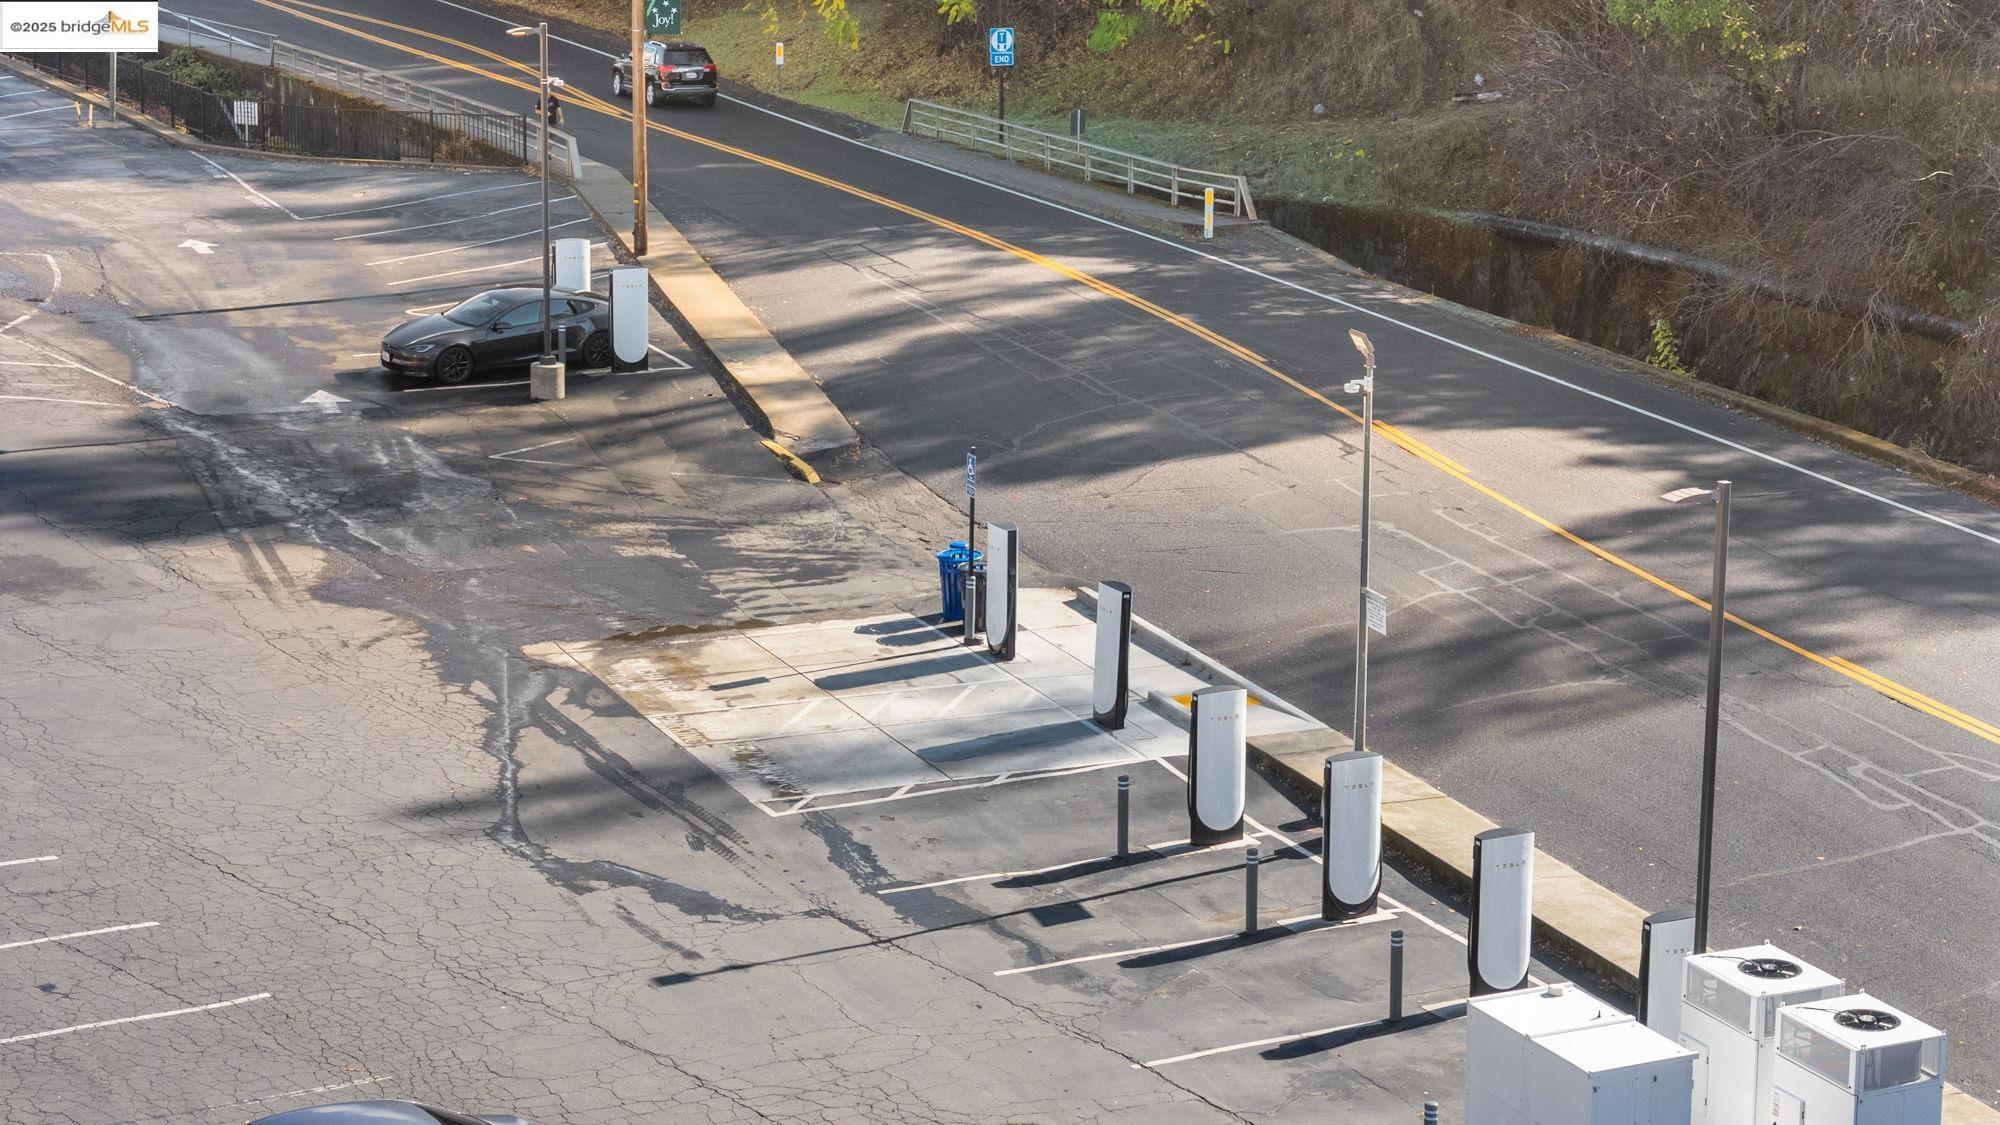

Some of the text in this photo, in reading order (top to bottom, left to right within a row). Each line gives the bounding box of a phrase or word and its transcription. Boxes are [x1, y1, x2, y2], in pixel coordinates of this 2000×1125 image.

[652, 13, 674, 28] Joy!
[994, 55, 1010, 63] END
[1210, 714, 1239, 722] TESLA
[1344, 782, 1374, 790] TESLA
[1496, 860, 1526, 870] TESLA
